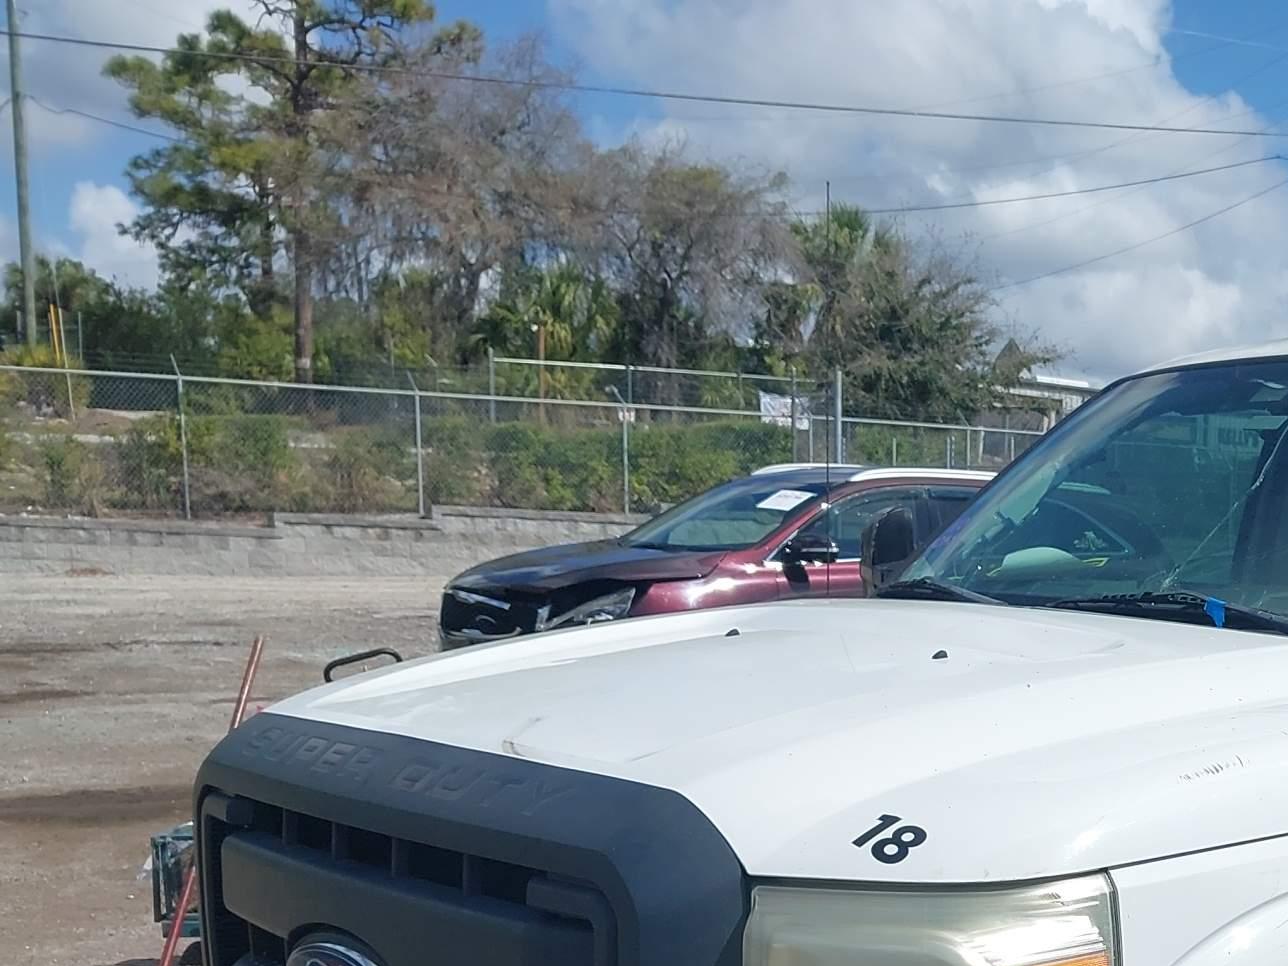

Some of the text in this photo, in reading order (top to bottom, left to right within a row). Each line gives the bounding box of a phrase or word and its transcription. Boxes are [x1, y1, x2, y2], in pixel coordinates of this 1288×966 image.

[242, 726, 577, 817] SUPER DUTY
[851, 814, 927, 864] 18
